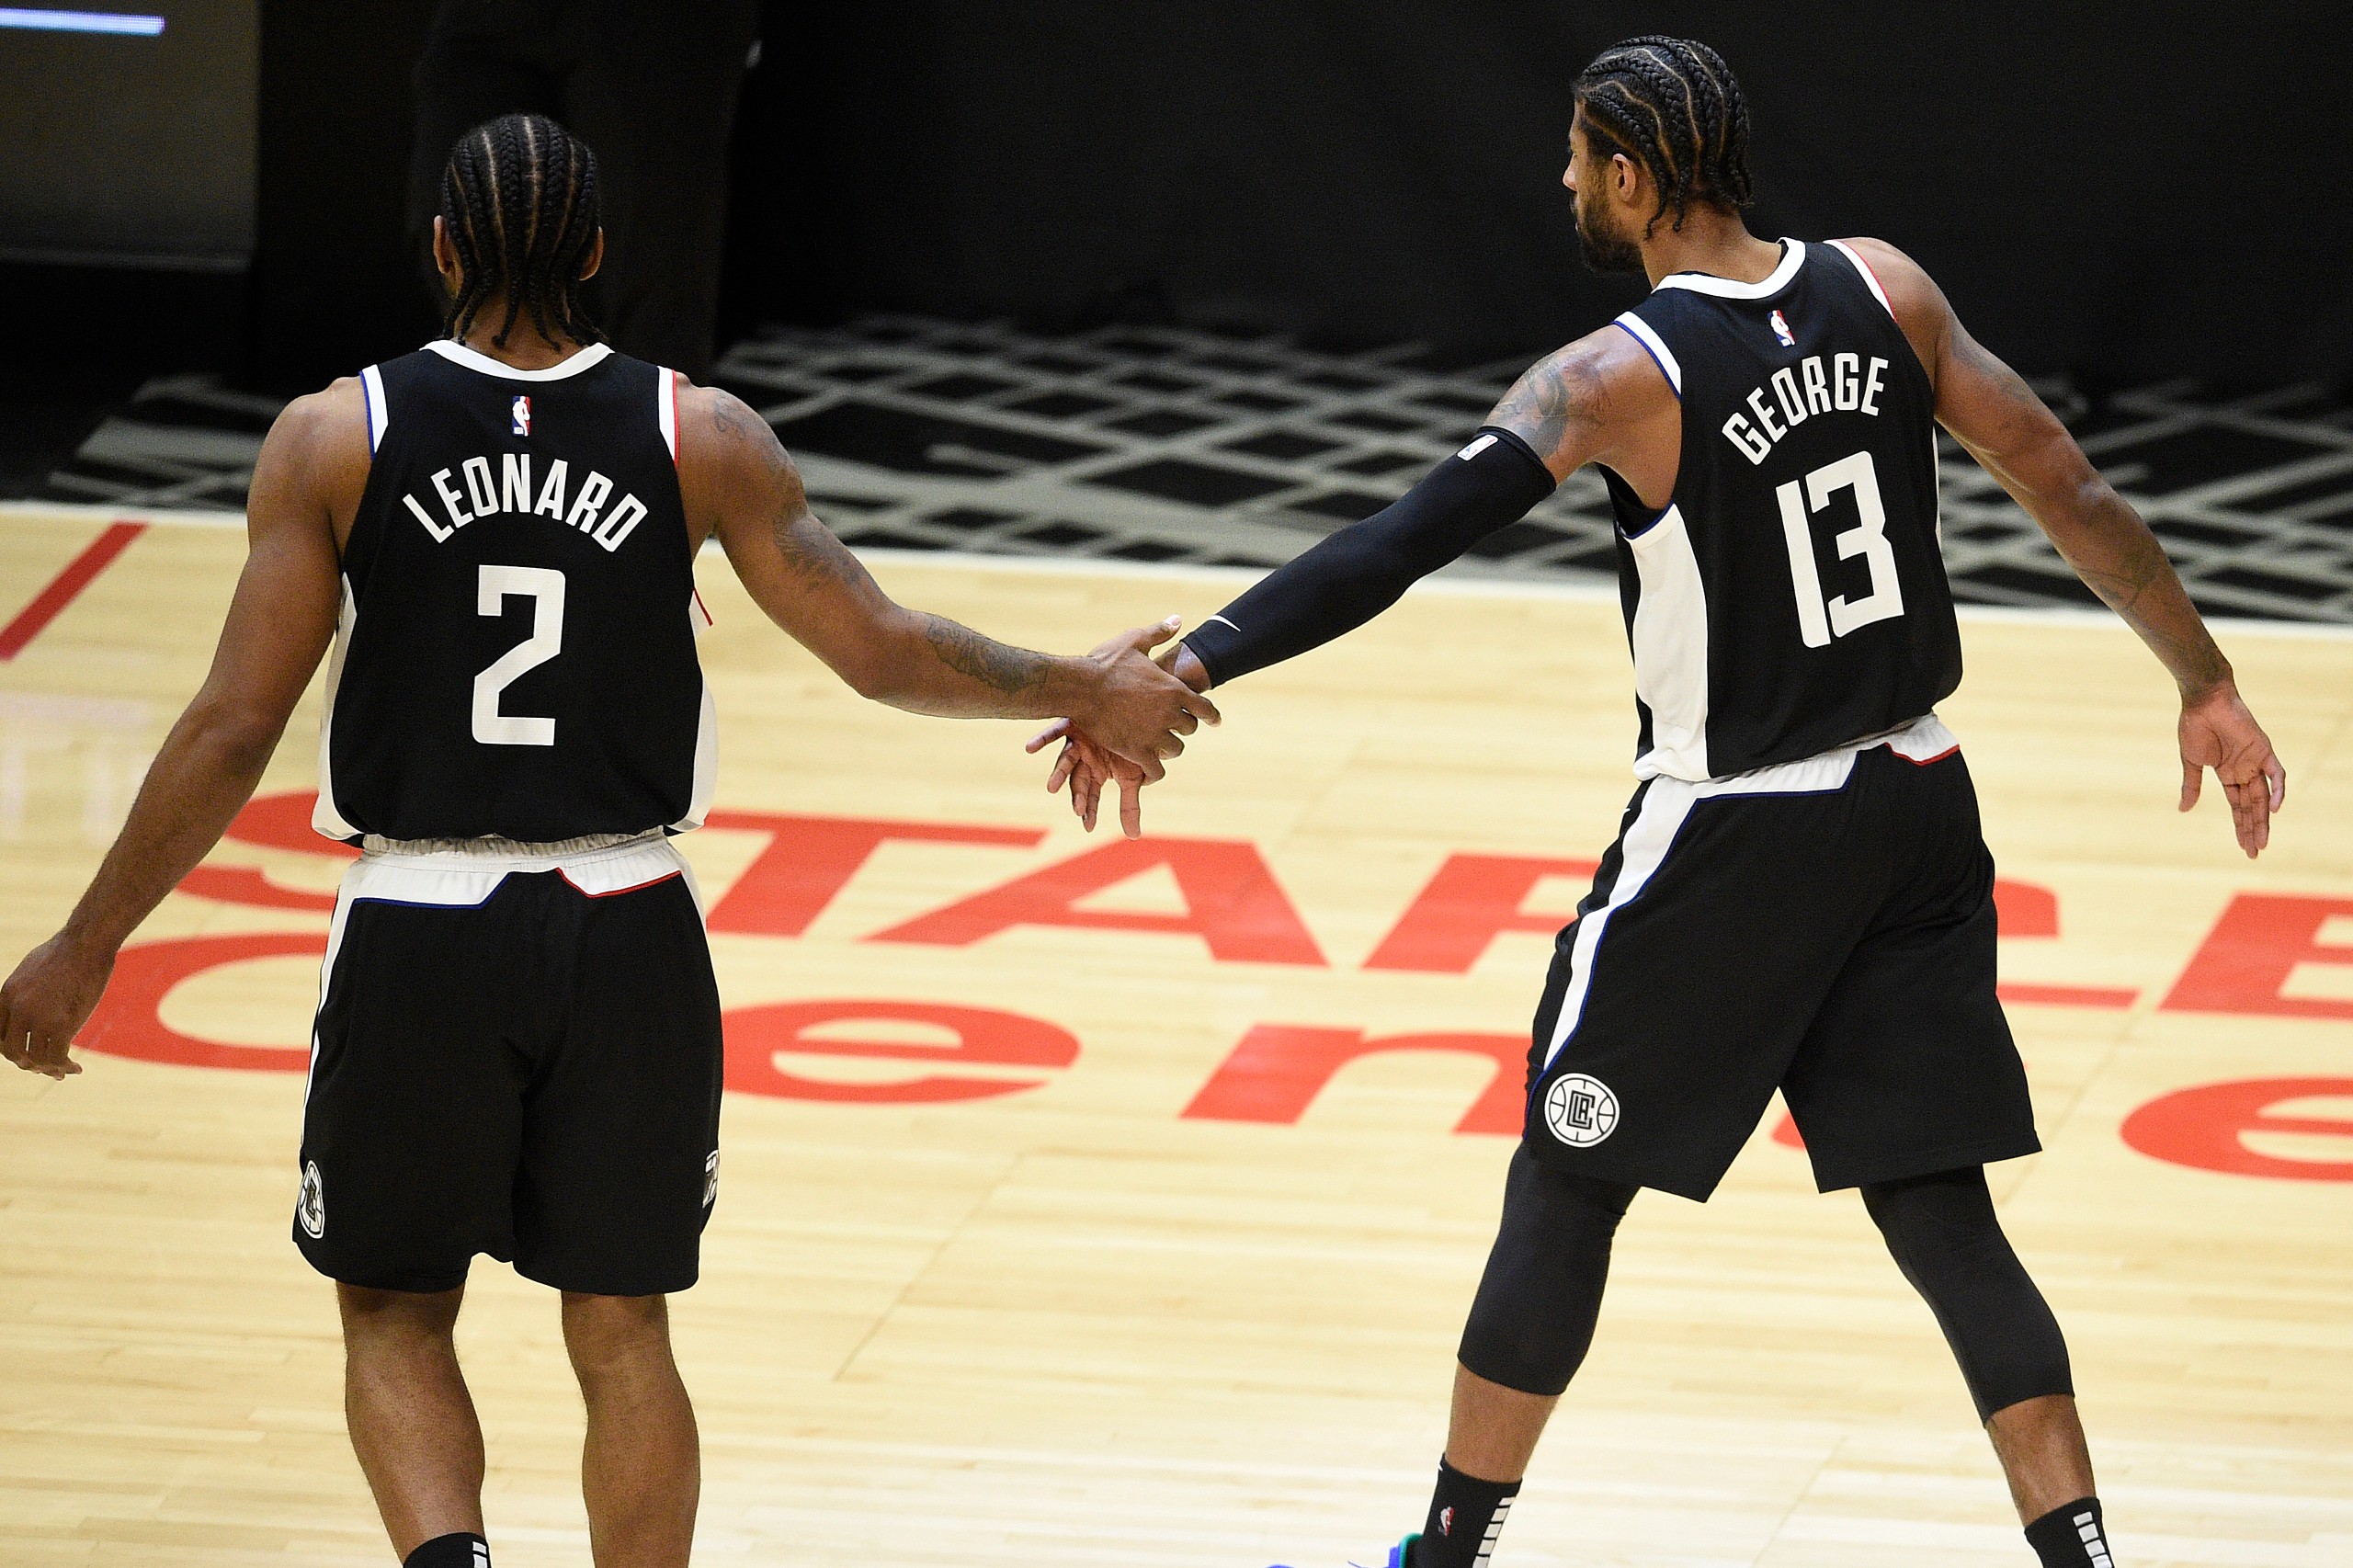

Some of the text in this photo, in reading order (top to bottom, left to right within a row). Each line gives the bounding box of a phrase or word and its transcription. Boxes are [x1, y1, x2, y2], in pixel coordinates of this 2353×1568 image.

[1722, 352, 1889, 465] GEORGE
[403, 453, 649, 552] LEONARD
[1775, 450, 1905, 649] 13
[472, 564, 566, 746] 2
